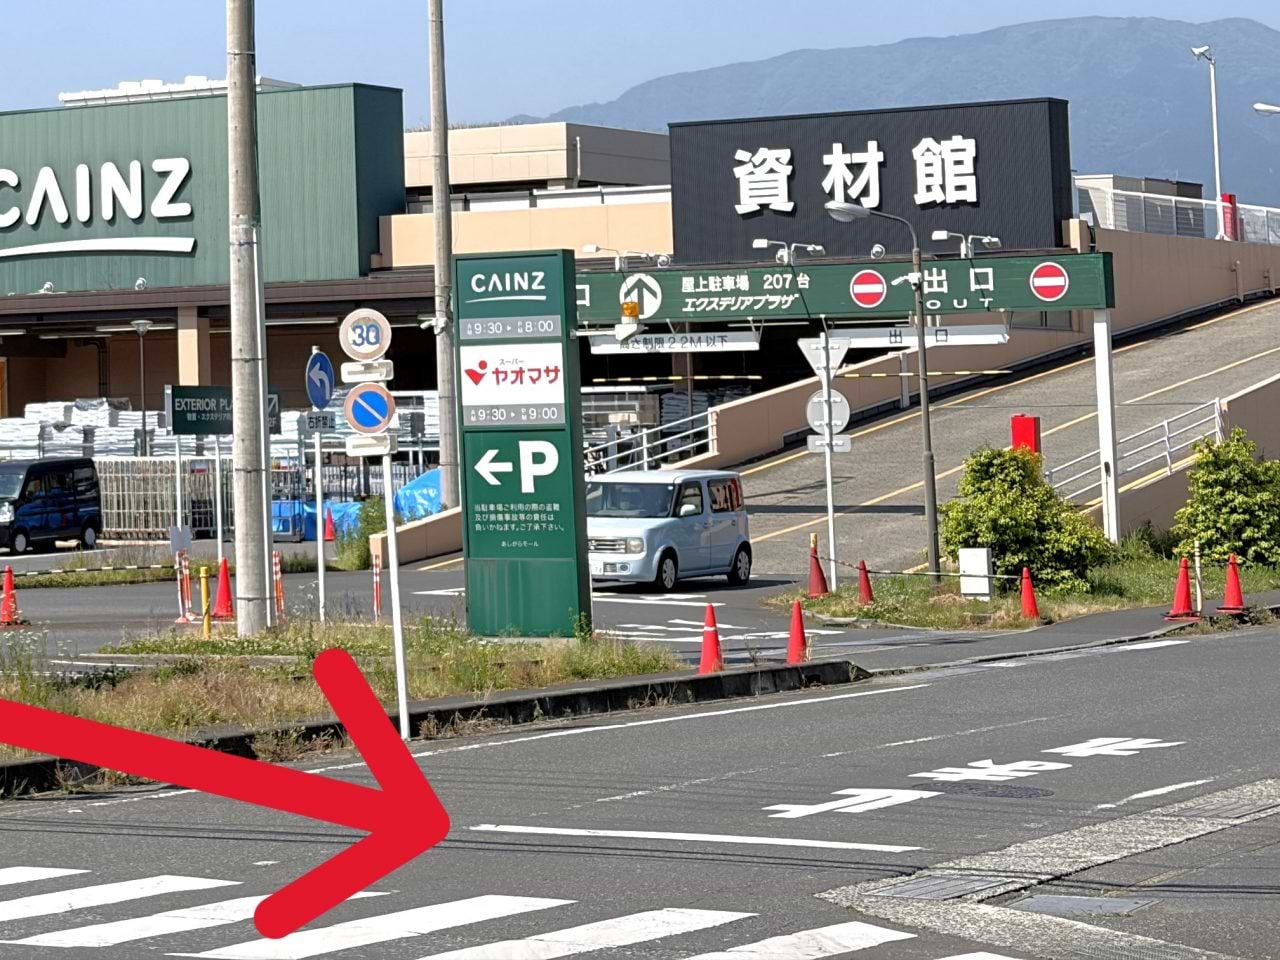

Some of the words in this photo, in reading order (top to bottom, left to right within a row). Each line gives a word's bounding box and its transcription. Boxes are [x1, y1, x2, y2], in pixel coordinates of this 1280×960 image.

[733, 135, 978, 215] 資材館
[471, 272, 545, 292] CAINZ
[682, 276, 749, 292] 屋上駐車場
[924, 268, 994, 294] 出口
[682, 294, 799, 312] エクステリアプラザ
[352, 323, 380, 347] 30
[474, 322, 502, 334] 9:30
[525, 320, 553, 332] 8:00
[492, 366, 560, 385] ヤオマサ
[175, 398, 217, 411] EXTERIOR
[478, 409, 506, 421] 9:30
[529, 407, 557, 420] 9:00
[518, 440, 559, 493] P
